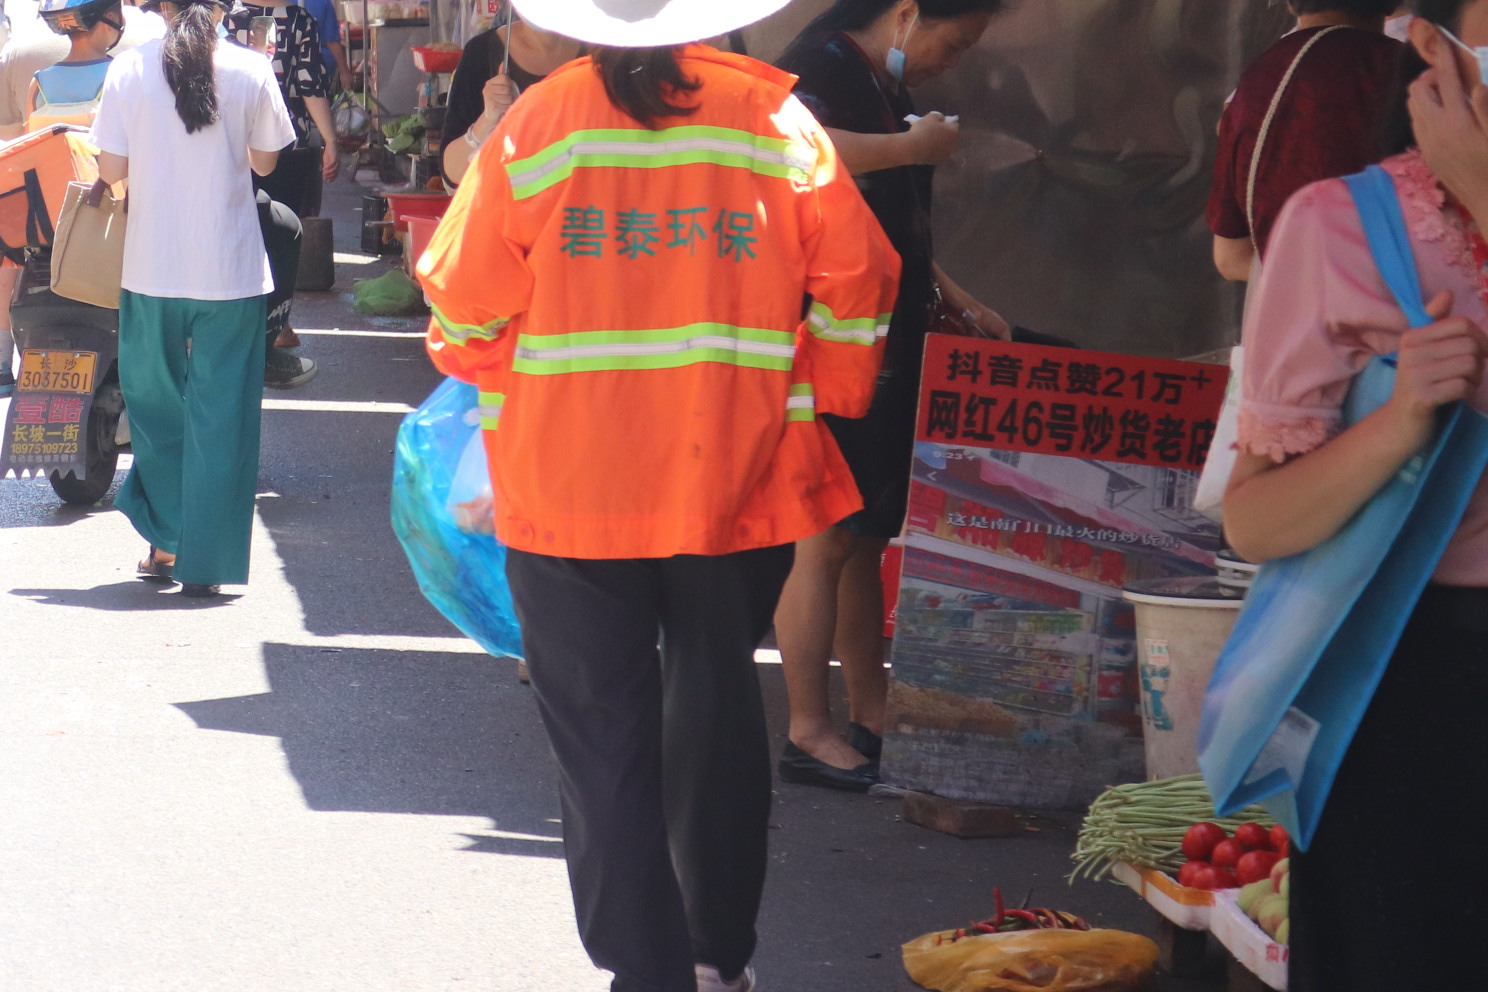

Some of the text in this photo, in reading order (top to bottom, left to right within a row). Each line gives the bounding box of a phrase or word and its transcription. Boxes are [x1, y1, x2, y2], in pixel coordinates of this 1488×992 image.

[560, 205, 757, 262] 碧泰环保
[40, 358, 77, 371] 长沙
[946, 349, 1213, 405] 抖音点赞21万+
[23, 371, 88, 390] 3037501
[12, 424, 79, 442] 长坡一街
[926, 389, 1218, 466] 网红46号炒货老店
[11, 442, 78, 454] 18975109723
[946, 512, 1182, 550] 这是南门口最火的炒货店
